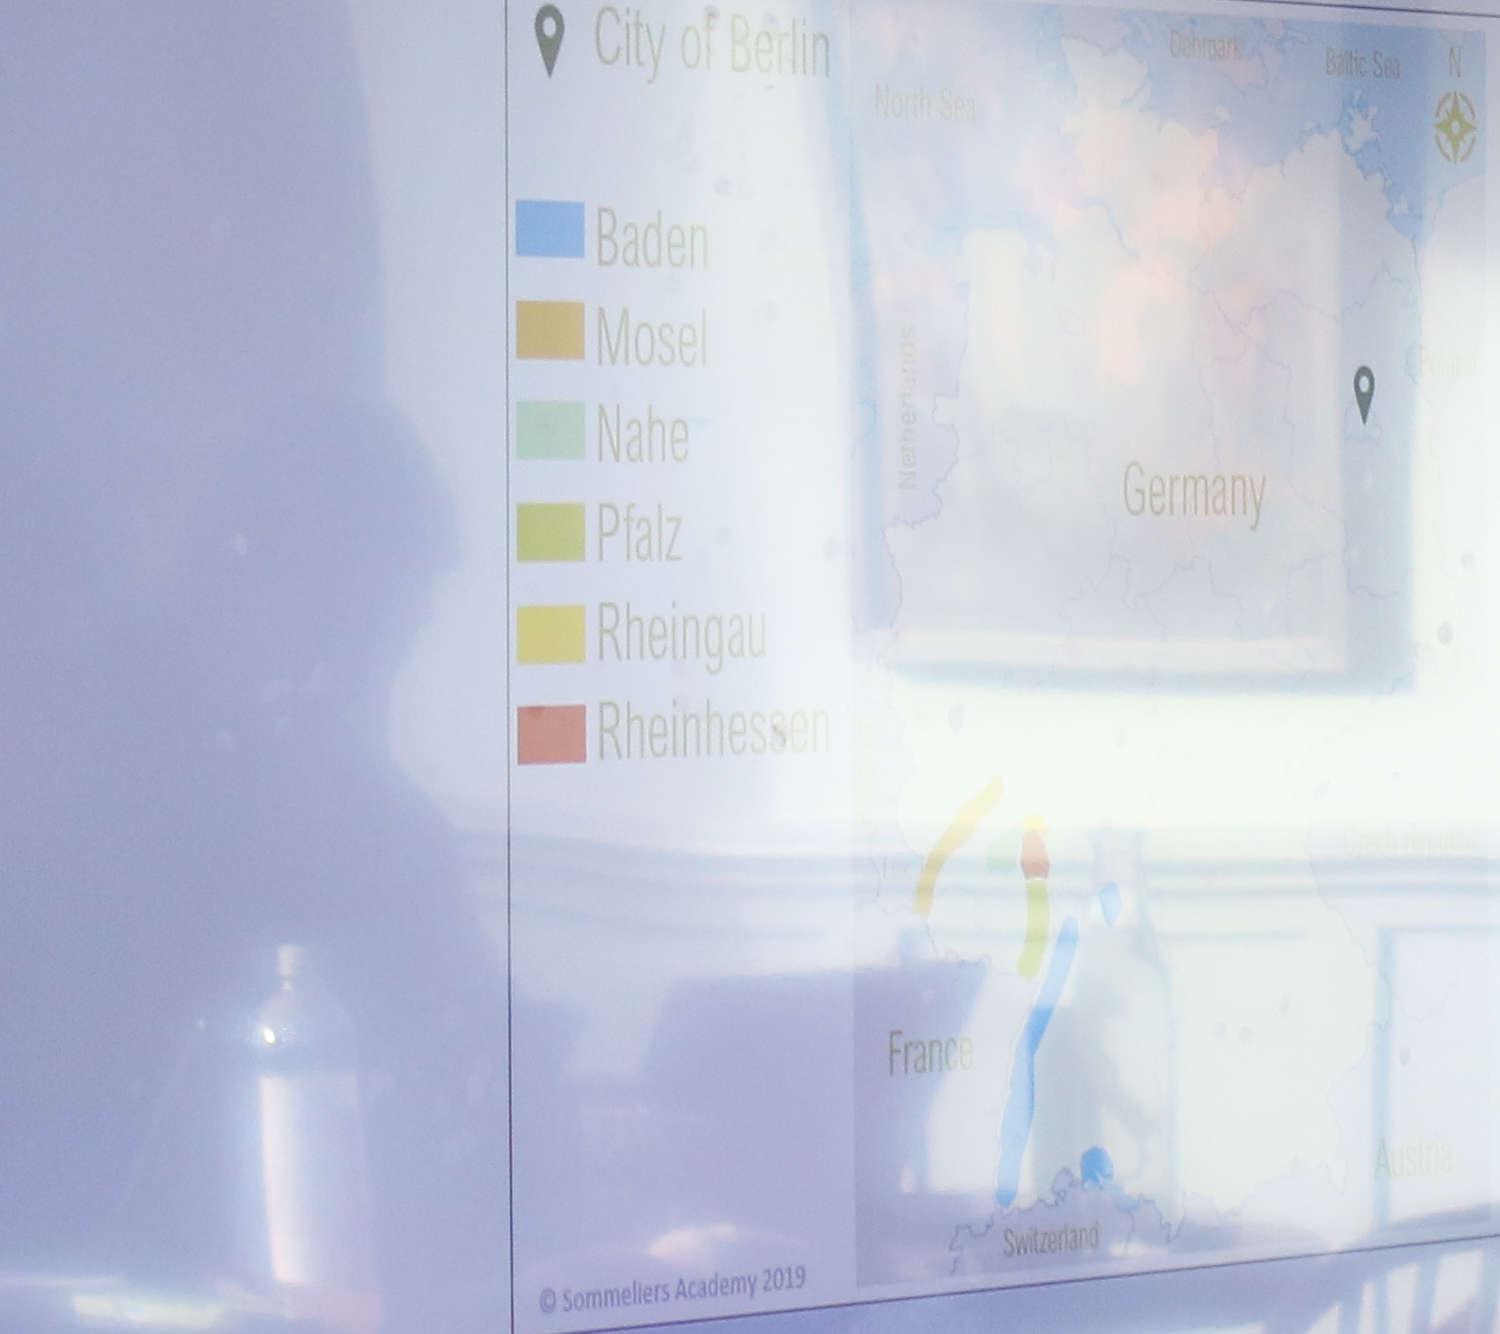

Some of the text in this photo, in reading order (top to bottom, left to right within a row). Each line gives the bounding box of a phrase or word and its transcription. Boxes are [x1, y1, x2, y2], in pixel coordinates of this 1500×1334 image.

[595, 6, 831, 85] City of Berlin
[1325, 46, 1367, 77] Baltic
[1448, 47, 1462, 78] N
[874, 83, 977, 121] North Sea
[597, 207, 708, 269] Baden
[597, 307, 707, 367] Mosel
[598, 404, 690, 464] Nahe
[1122, 459, 1267, 531] Germany
[598, 501, 684, 563] Pfalz
[598, 600, 767, 676] Rheingau
[599, 698, 831, 761] Rheinhessen
[888, 1029, 974, 1078] France
[1003, 1220, 1100, 1257] Switzerland
[562, 1278, 670, 1313] Sommeliers
[675, 1271, 757, 1300] Academy
[762, 1265, 807, 1294] 2019
